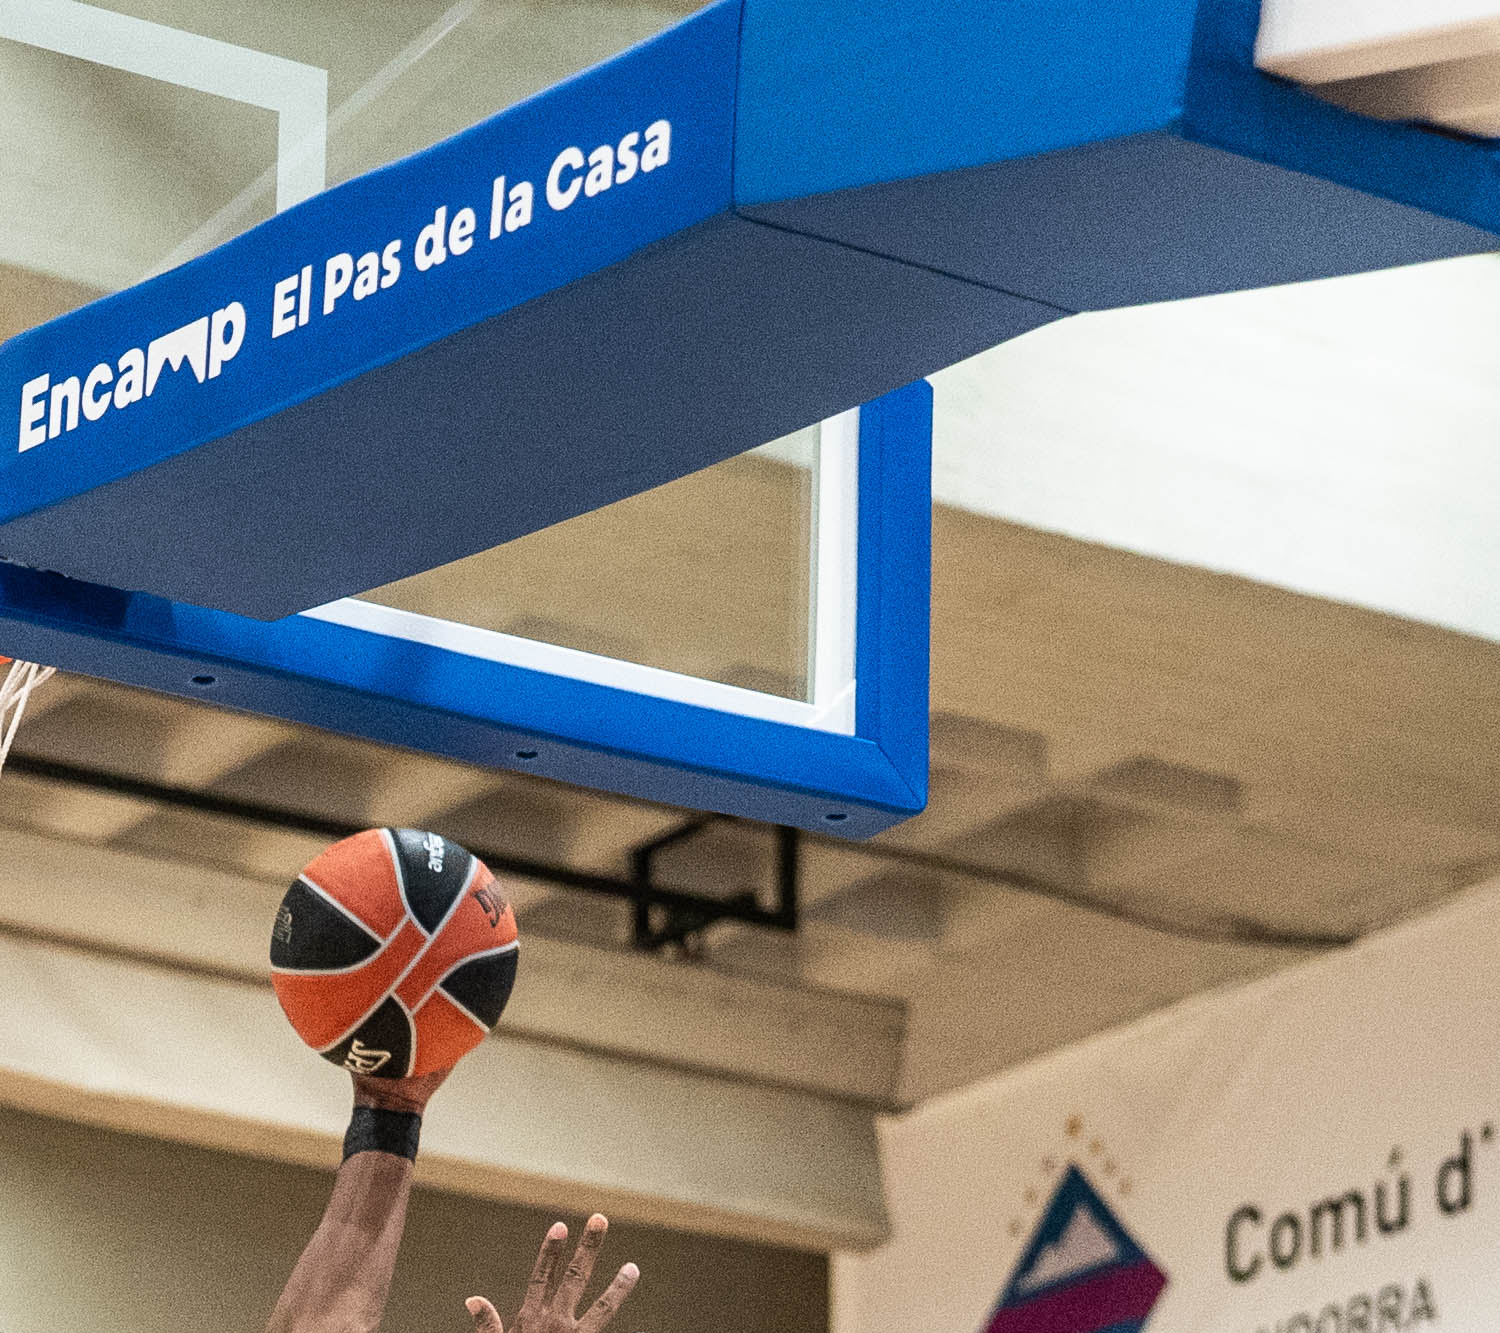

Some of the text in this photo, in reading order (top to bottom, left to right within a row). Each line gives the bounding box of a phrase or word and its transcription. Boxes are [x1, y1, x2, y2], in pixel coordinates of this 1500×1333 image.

[17, 119, 672, 453] Encamp El Pas de la Casa
[1222, 1143, 1413, 1285] Comú
